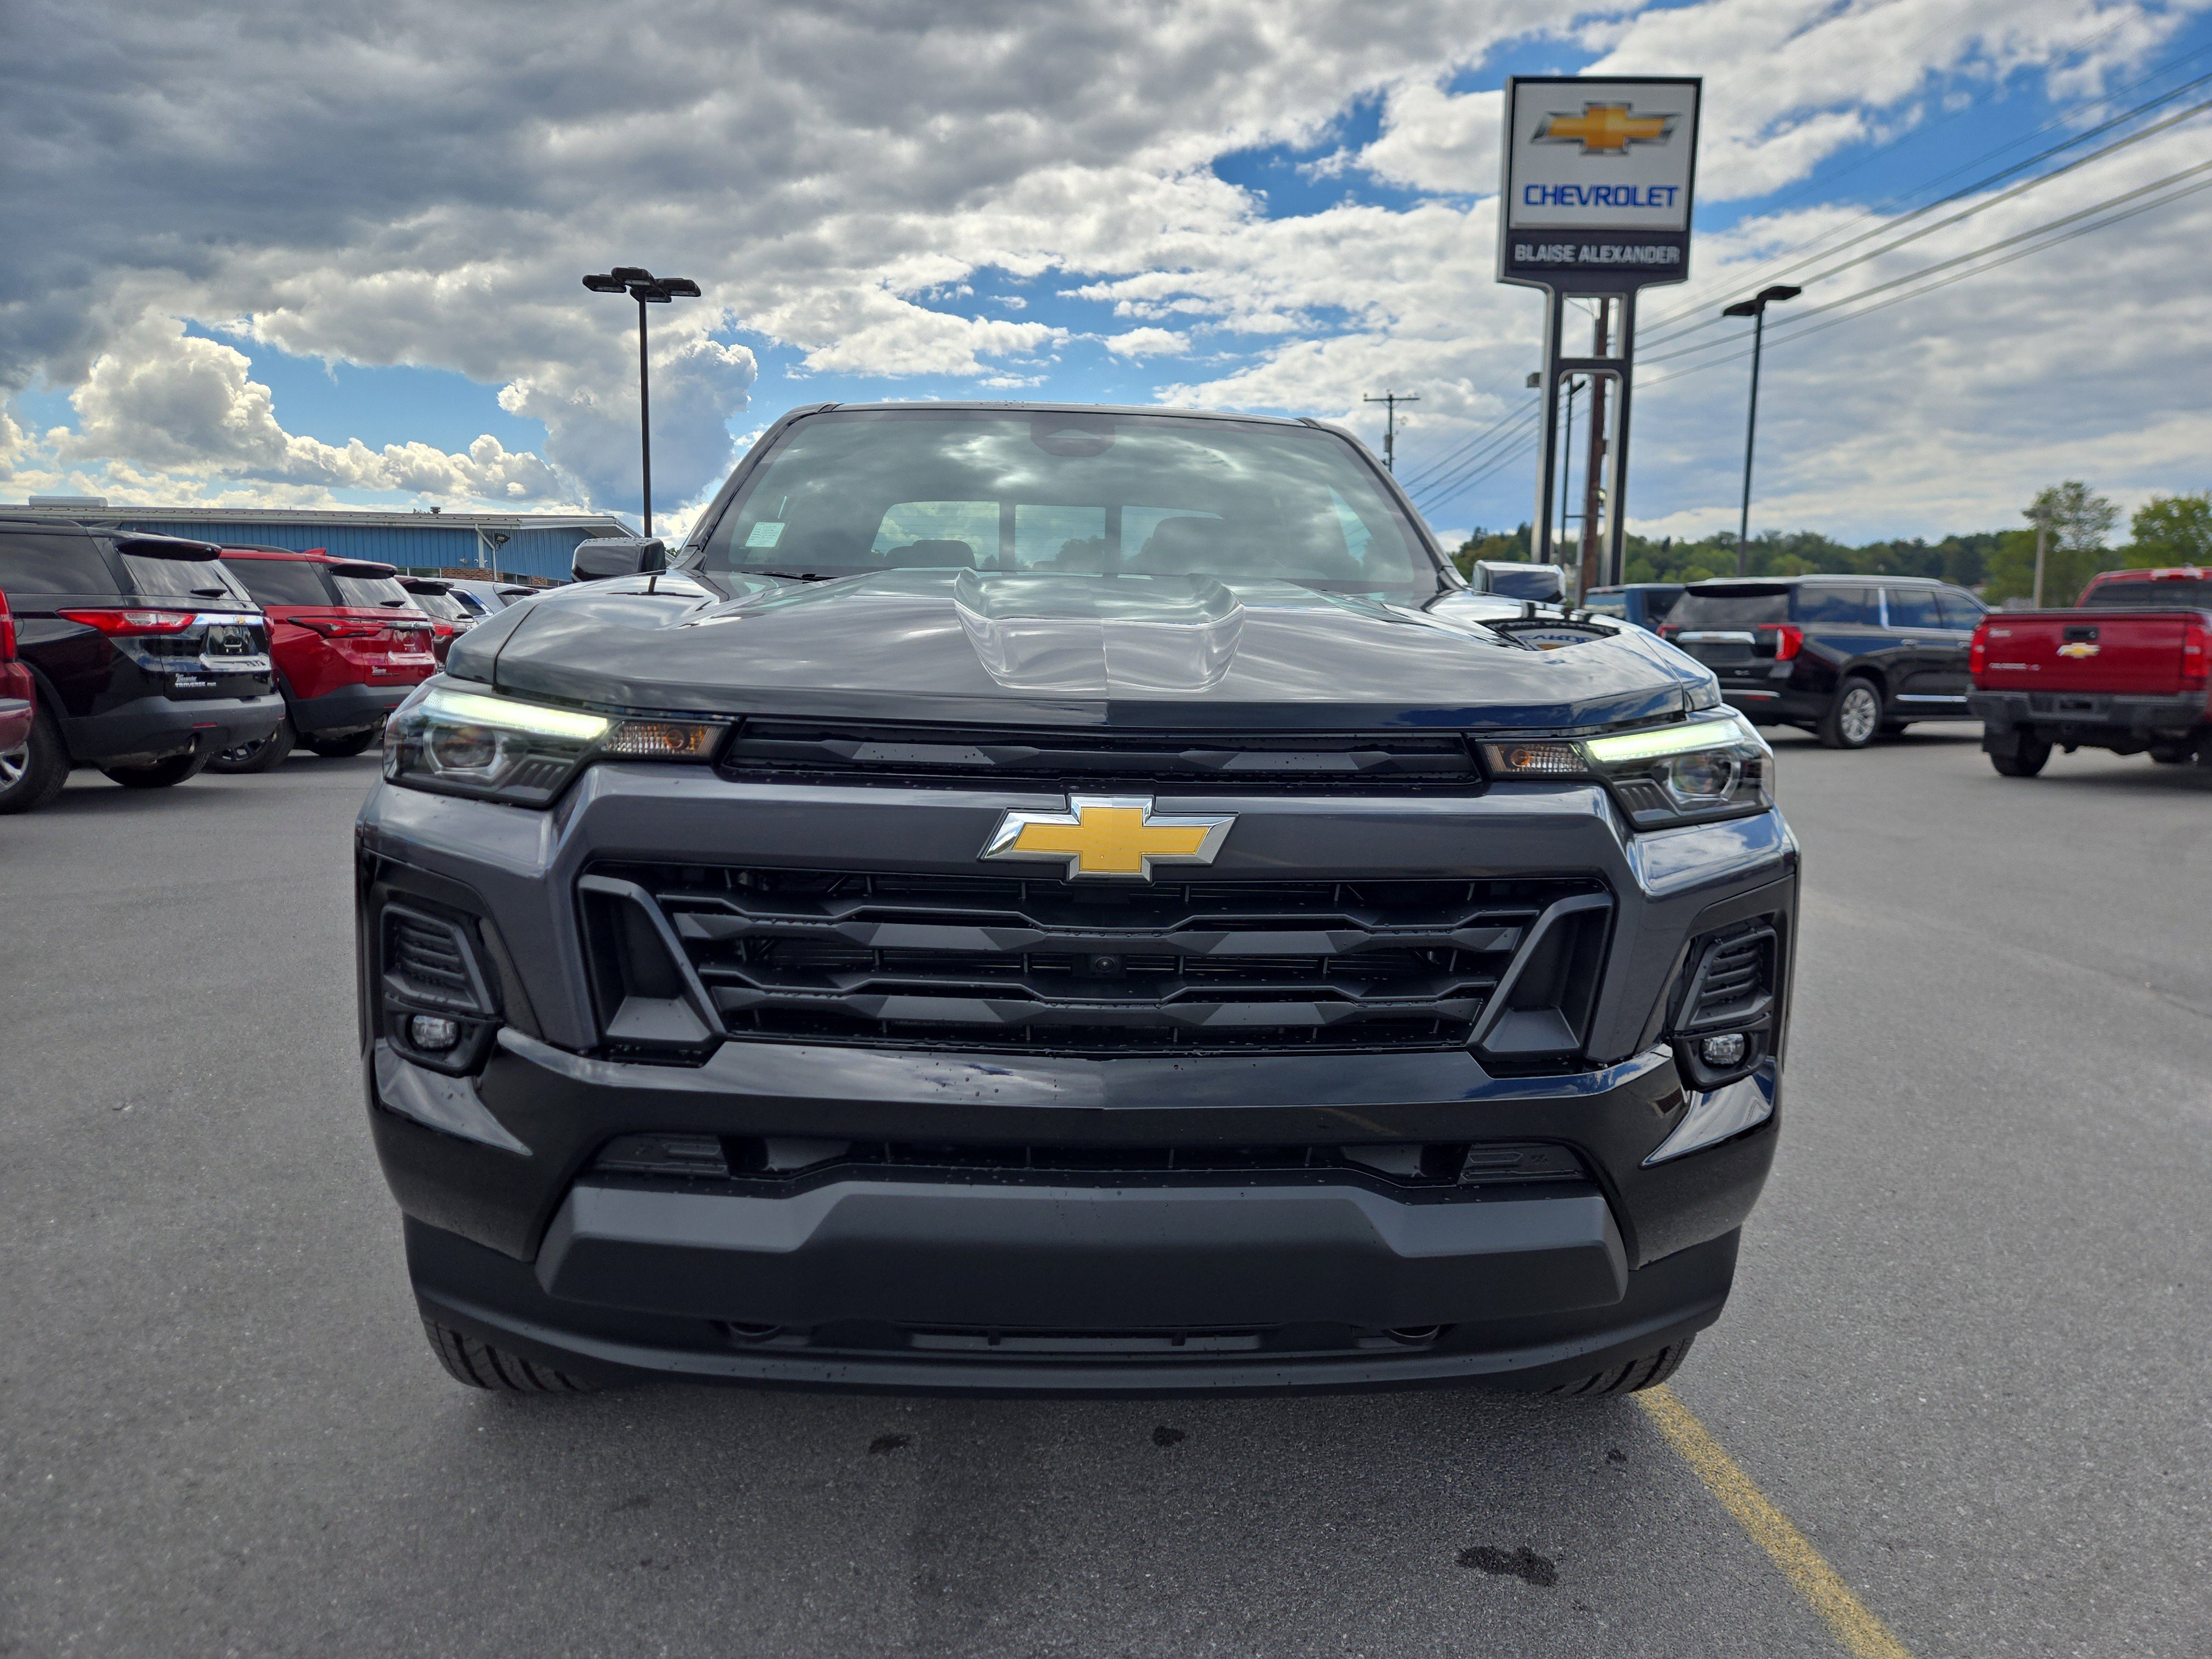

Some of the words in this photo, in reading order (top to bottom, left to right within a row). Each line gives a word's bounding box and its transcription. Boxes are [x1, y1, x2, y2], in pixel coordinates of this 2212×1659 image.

[1525, 184, 1679, 207] CHEVROLET
[1515, 243, 1577, 263] BLAISE
[1578, 245, 1681, 264] ALEXANDER
